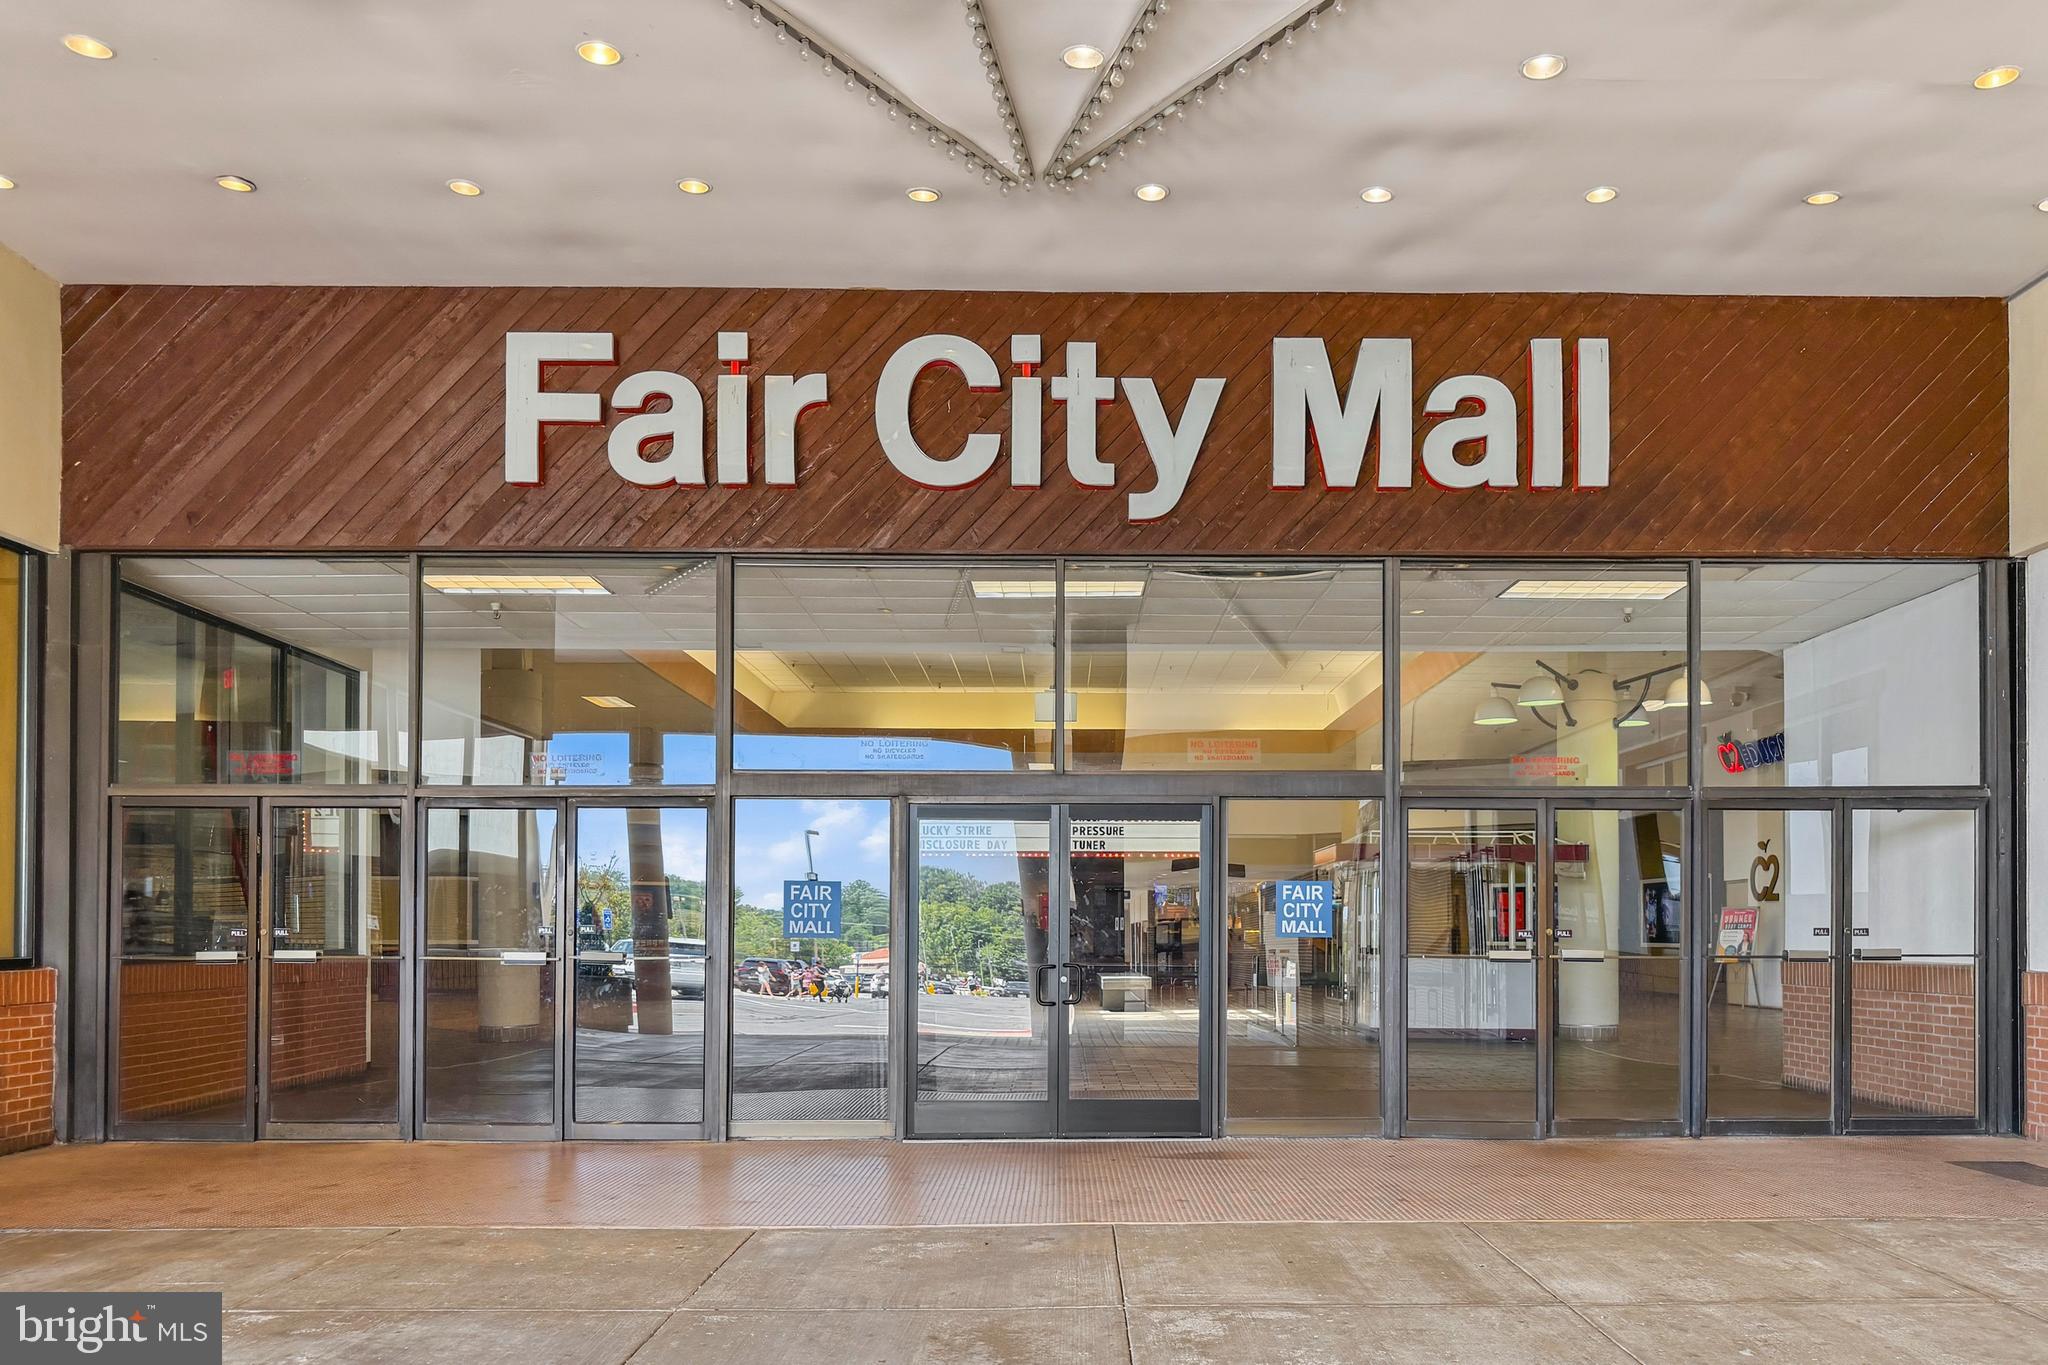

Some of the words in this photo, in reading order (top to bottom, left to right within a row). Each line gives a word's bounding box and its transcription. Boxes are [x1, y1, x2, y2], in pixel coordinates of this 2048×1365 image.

[505, 331, 828, 488] Fair
[875, 333, 1227, 524] City
[1269, 337, 1610, 491] Mall
[1738, 731, 1784, 769] EDUC
[921, 825, 951, 836] UCKY
[956, 825, 992, 836] STRIKE
[1072, 826, 1125, 836] PRESSURE
[921, 840, 980, 850] ISCLOSURE
[987, 840, 1008, 850] DAY
[1073, 840, 1106, 850] TUNER
[790, 884, 833, 900] FAIR
[1282, 884, 1324, 900] FAIR
[790, 902, 832, 918] CITY
[1283, 902, 1324, 918] CITY
[789, 920, 835, 934] MALL
[1281, 920, 1327, 934] MALL
